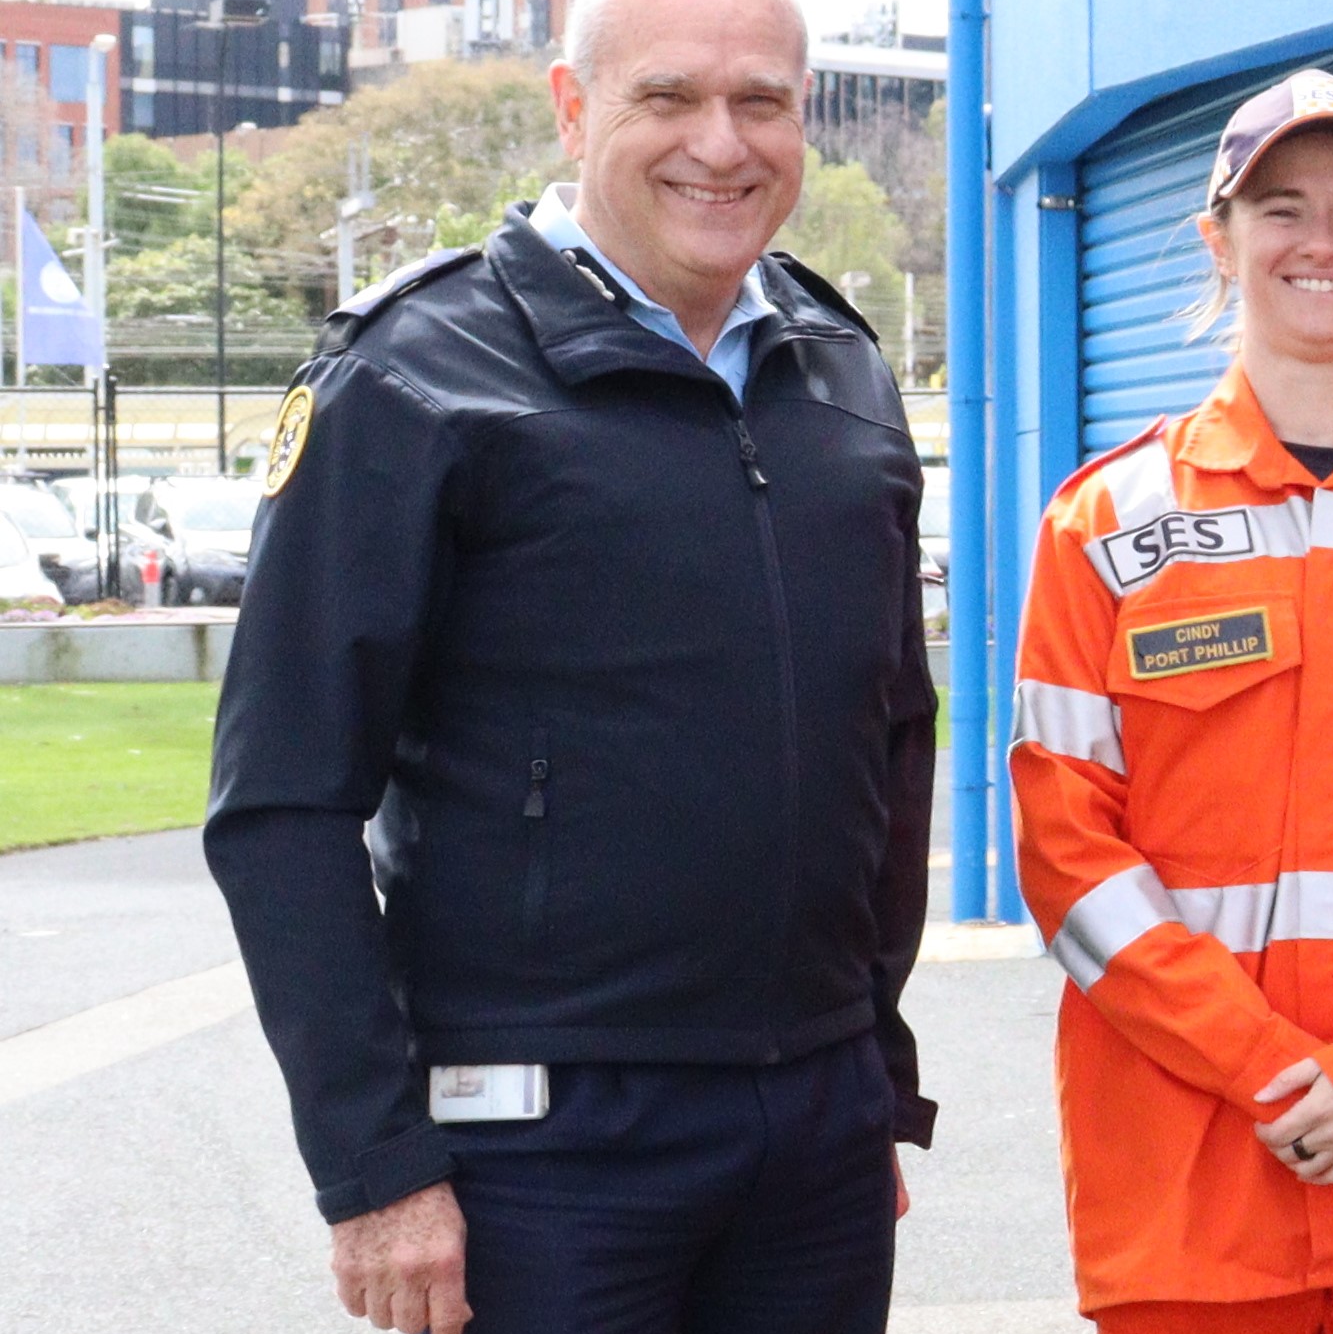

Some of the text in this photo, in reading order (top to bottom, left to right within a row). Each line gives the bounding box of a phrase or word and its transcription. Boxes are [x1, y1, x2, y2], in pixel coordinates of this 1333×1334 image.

[1132, 516, 1224, 569] SES
[1175, 623, 1220, 643] CINDY
[1144, 637, 1258, 669] PORT PHILLIP
